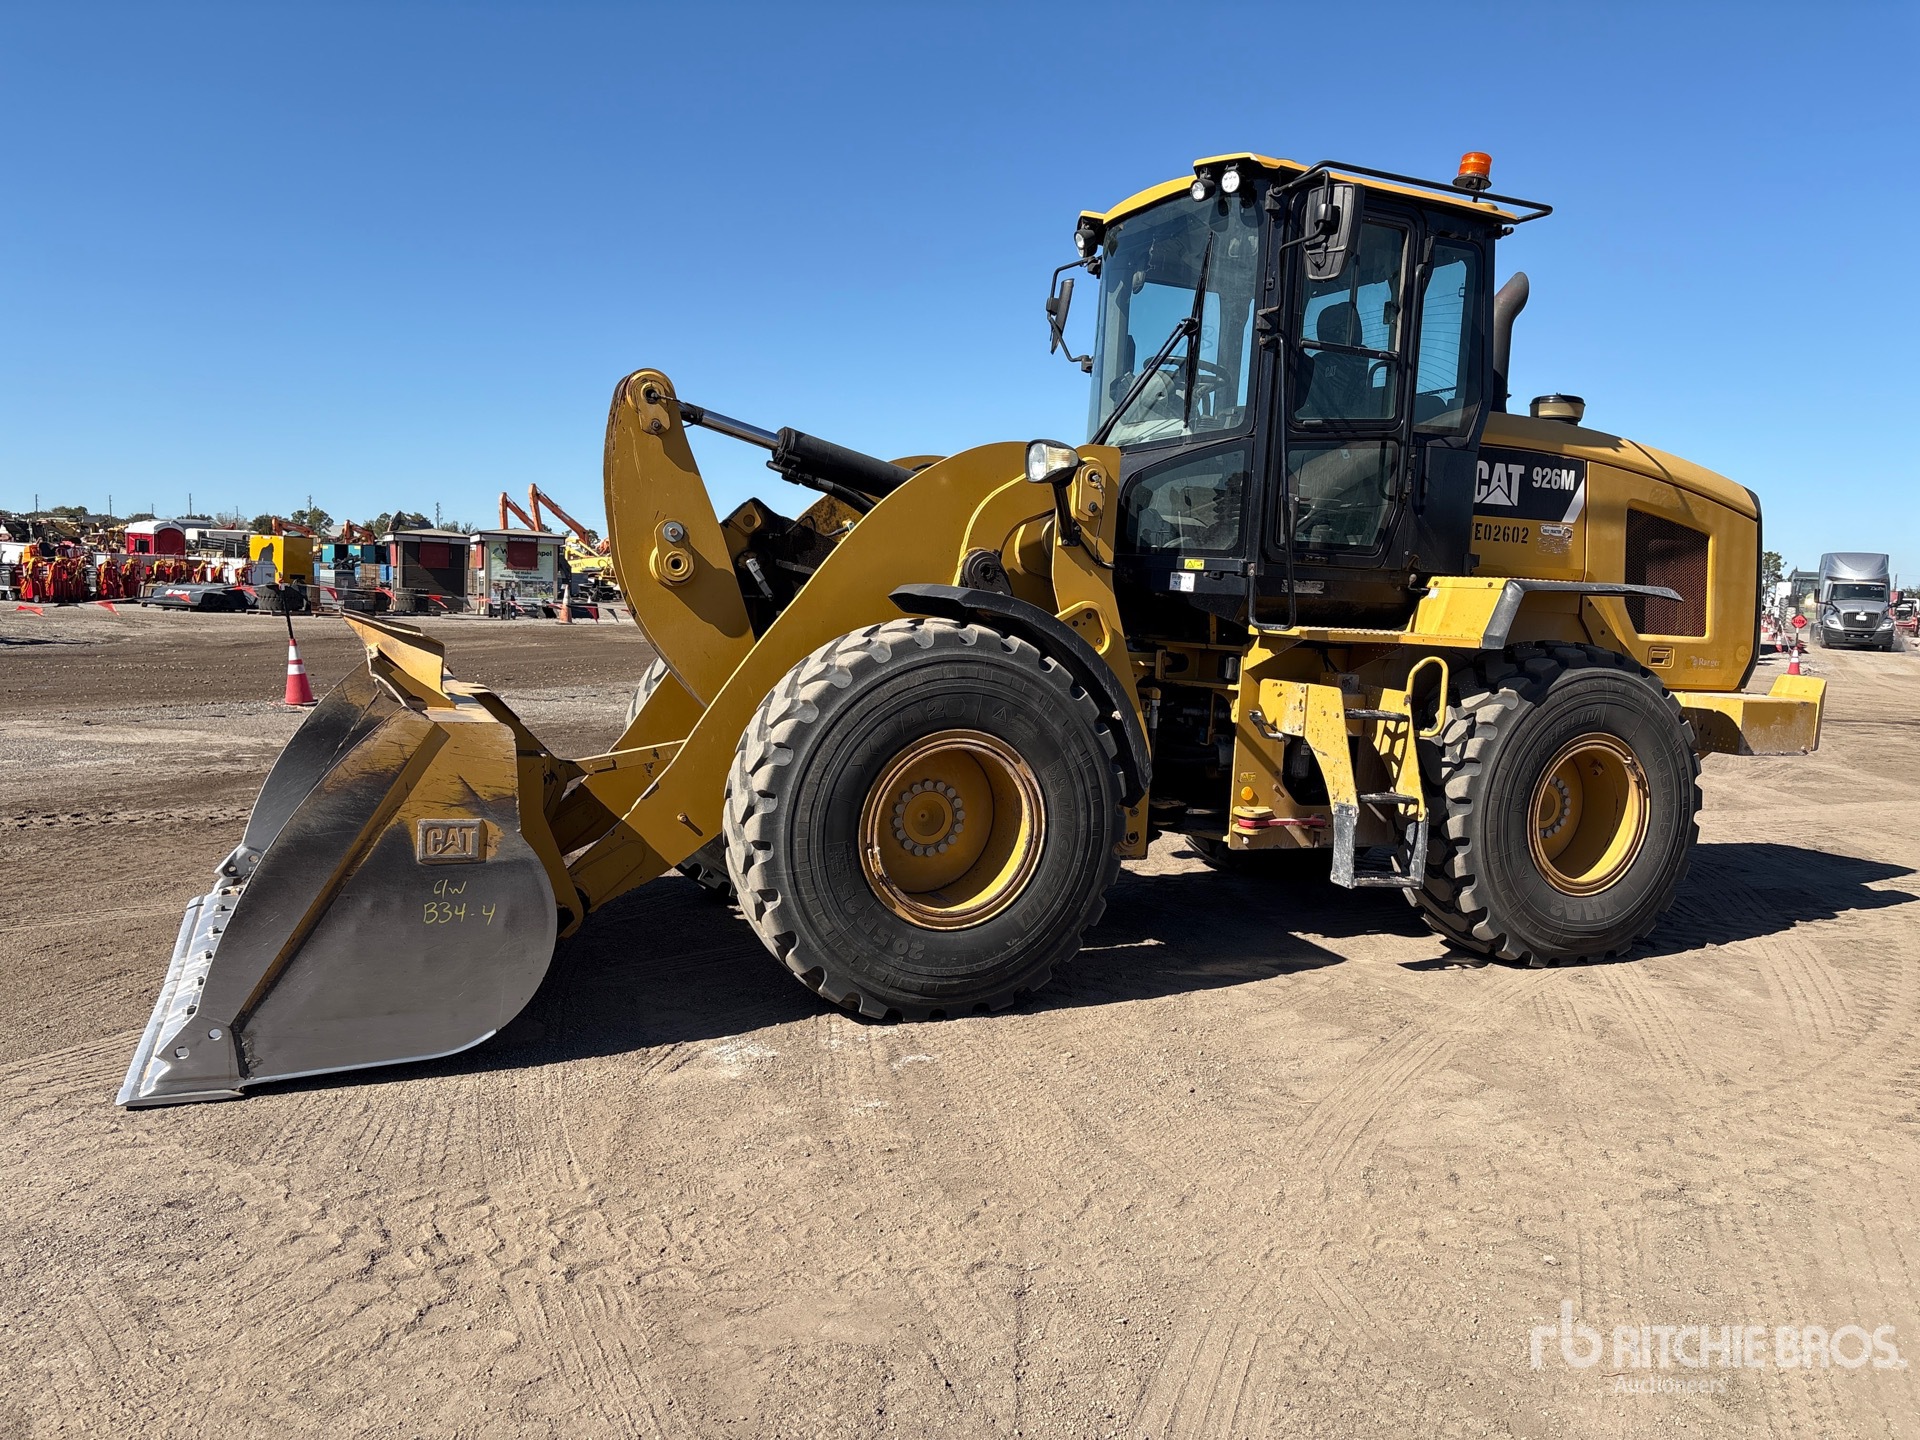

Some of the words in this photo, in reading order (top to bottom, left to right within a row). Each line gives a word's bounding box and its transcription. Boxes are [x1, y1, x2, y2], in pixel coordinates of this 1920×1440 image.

[1474, 460, 1525, 507] CAT
[1532, 467, 1576, 491] 926M
[1472, 522, 1529, 544] E02602
[425, 826, 477, 856] CAT
